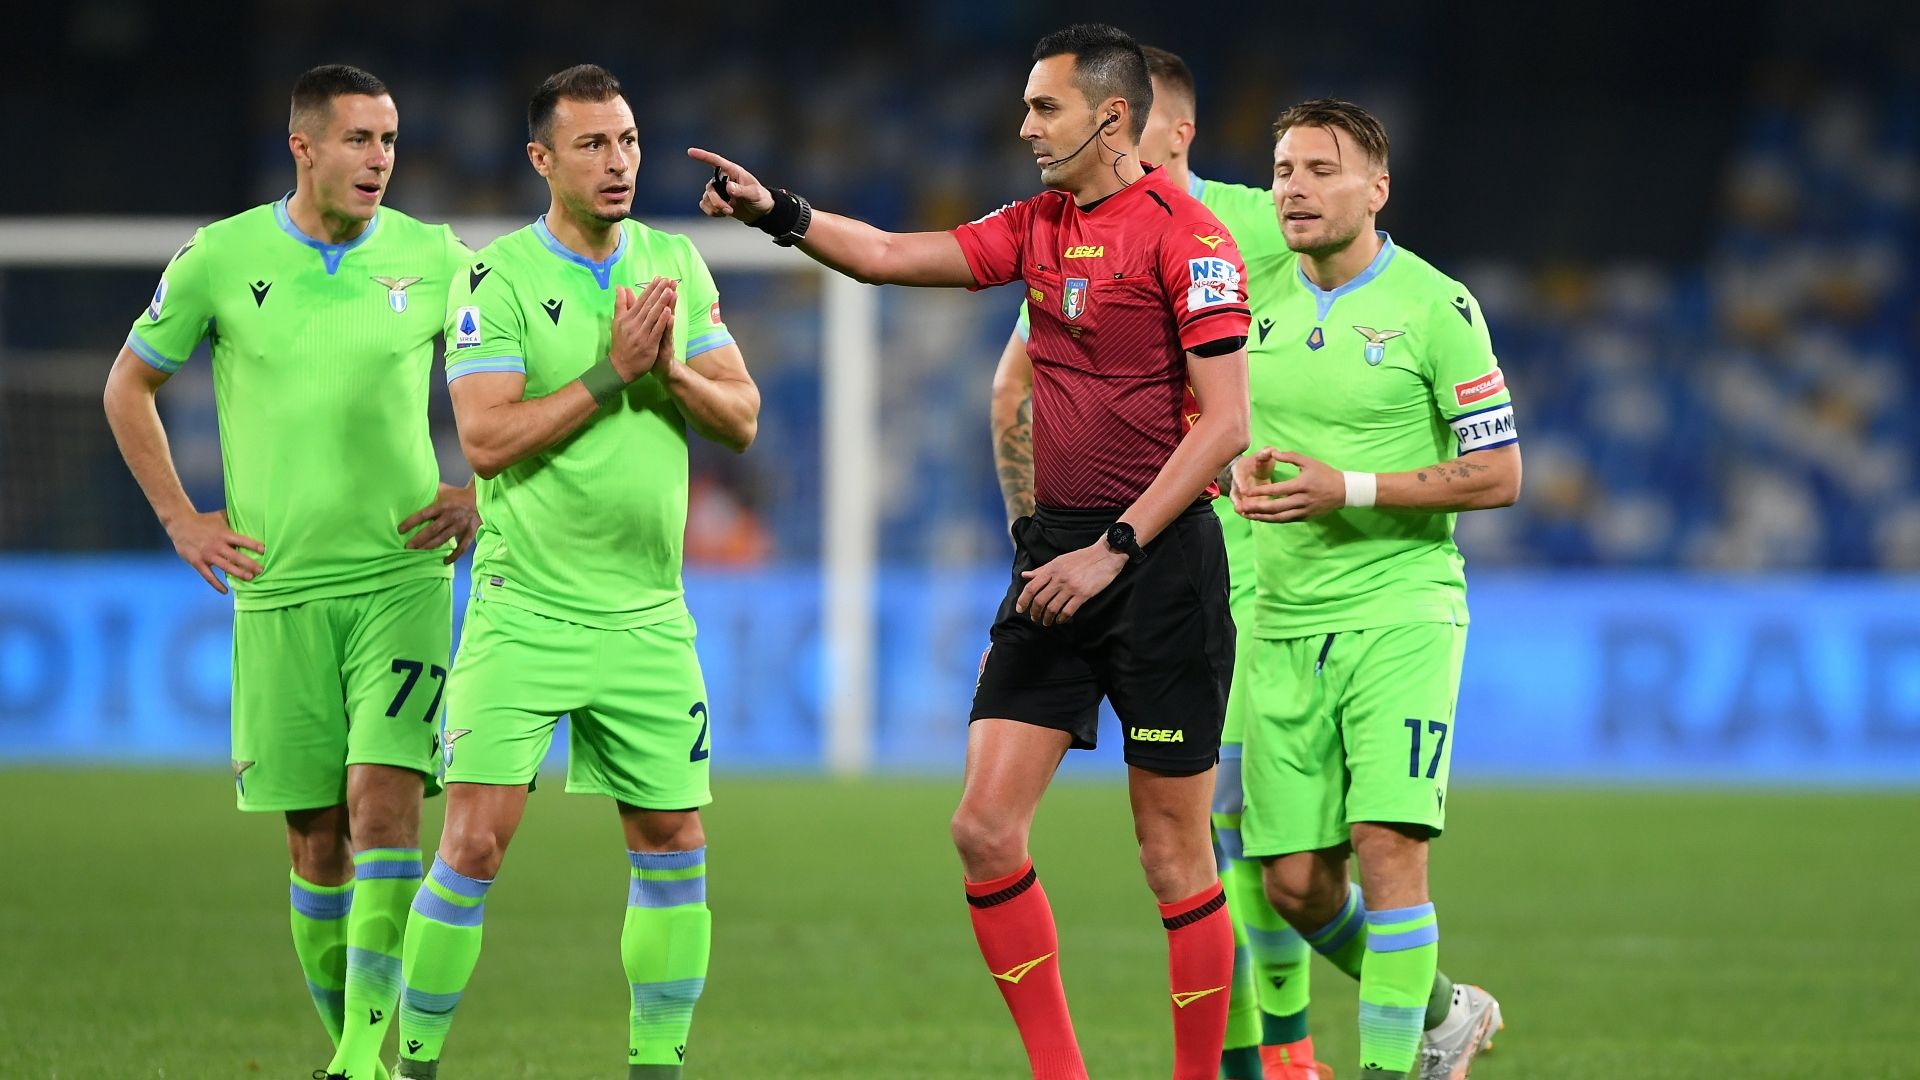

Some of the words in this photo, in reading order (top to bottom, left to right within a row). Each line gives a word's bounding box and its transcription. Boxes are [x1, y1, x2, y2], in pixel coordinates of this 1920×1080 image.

[1064, 245, 1104, 258] LEGEA
[385, 659, 446, 723] 77
[1130, 726, 1184, 742] LEGEA
[1404, 718, 1447, 779] 17
